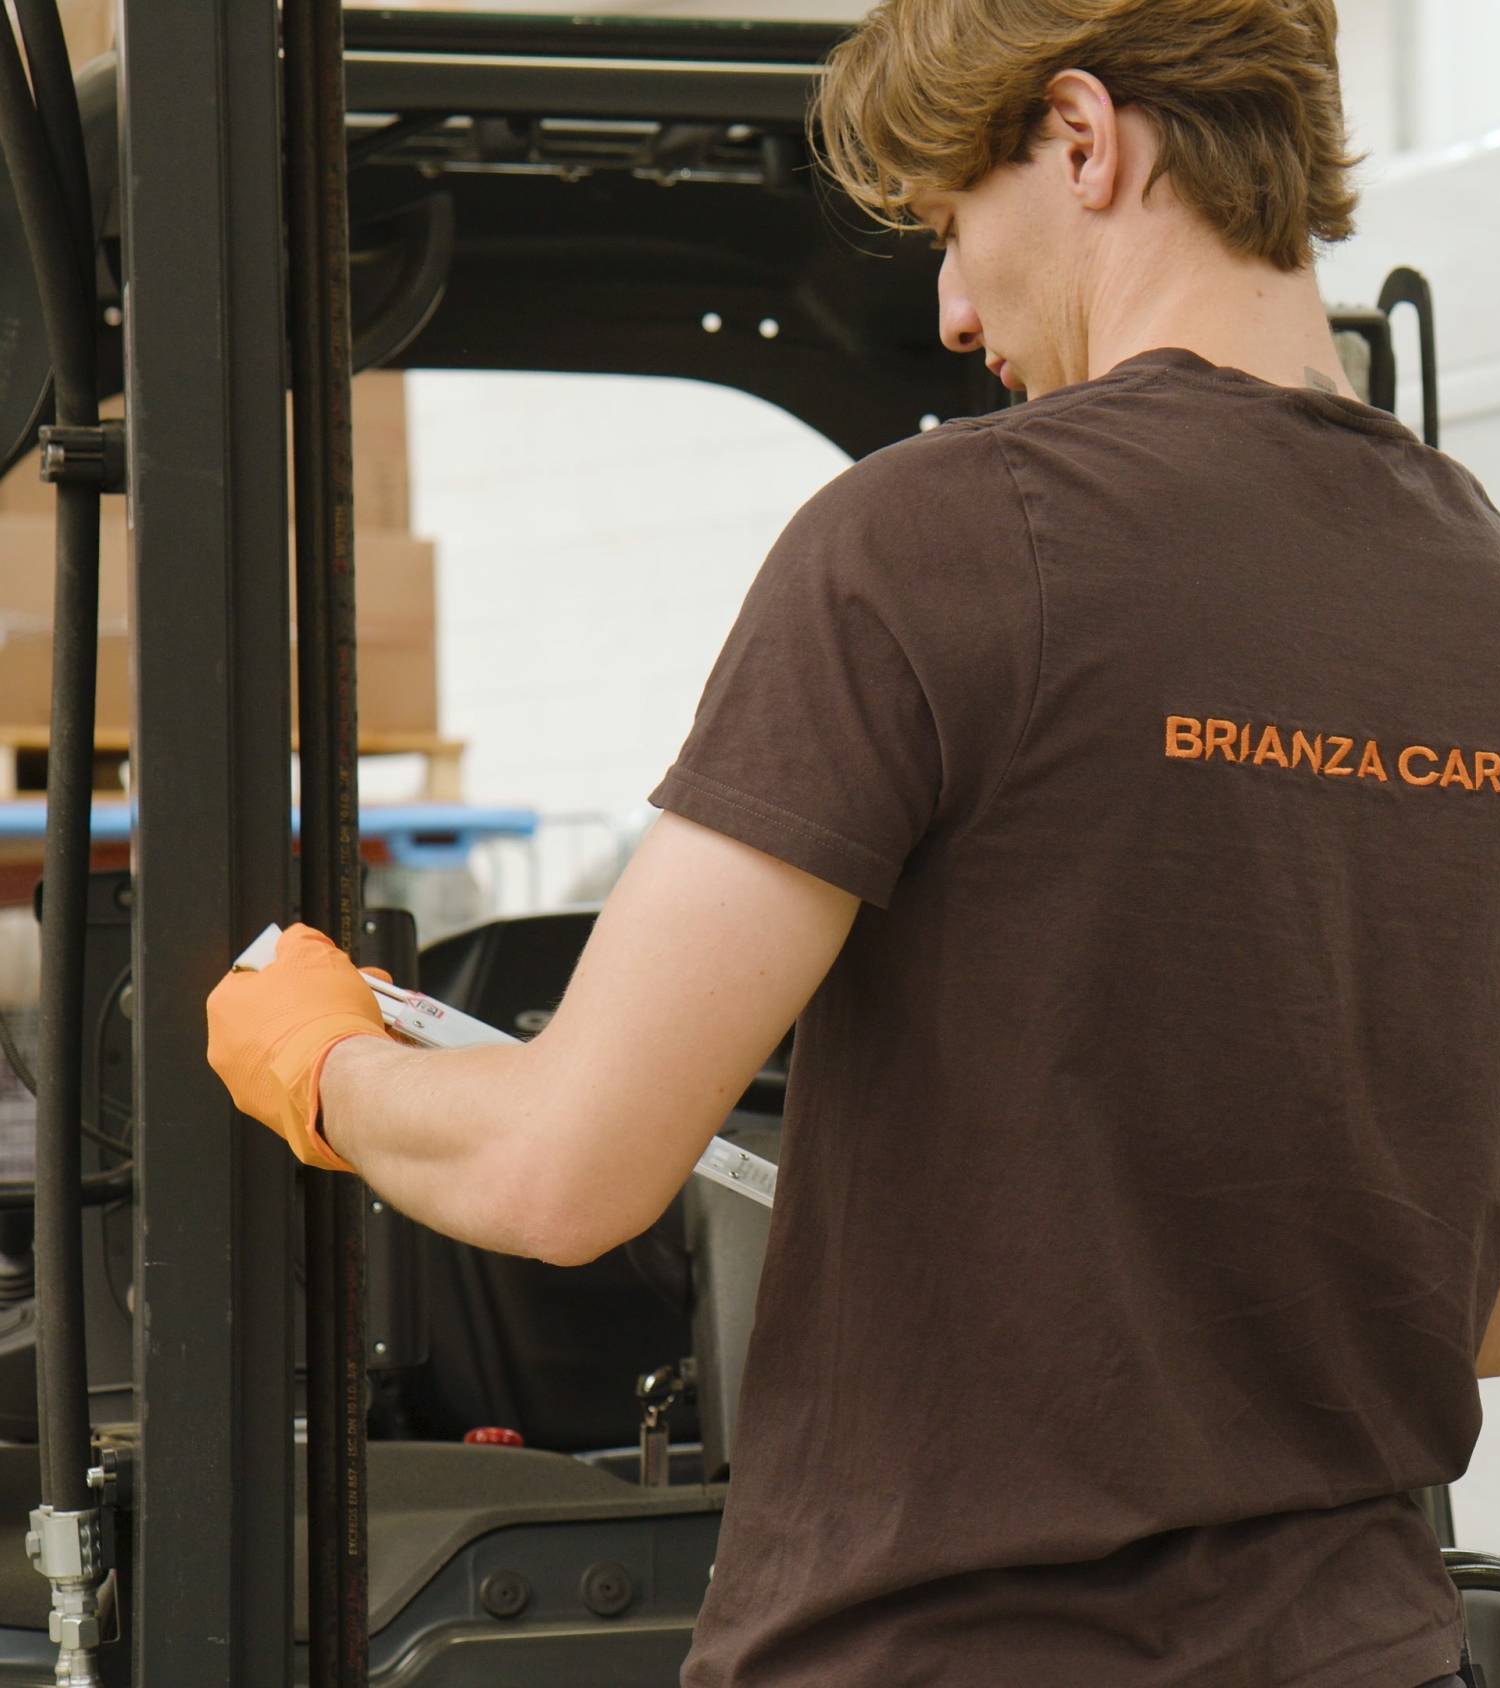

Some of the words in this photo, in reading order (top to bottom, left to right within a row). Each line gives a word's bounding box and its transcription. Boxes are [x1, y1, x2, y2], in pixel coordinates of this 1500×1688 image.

[1165, 714, 1388, 783] BRIANZA
[347, 1418, 358, 1435] DN
[347, 1490, 358, 1505] EN
[347, 1507, 359, 1556] EXCEEDS
